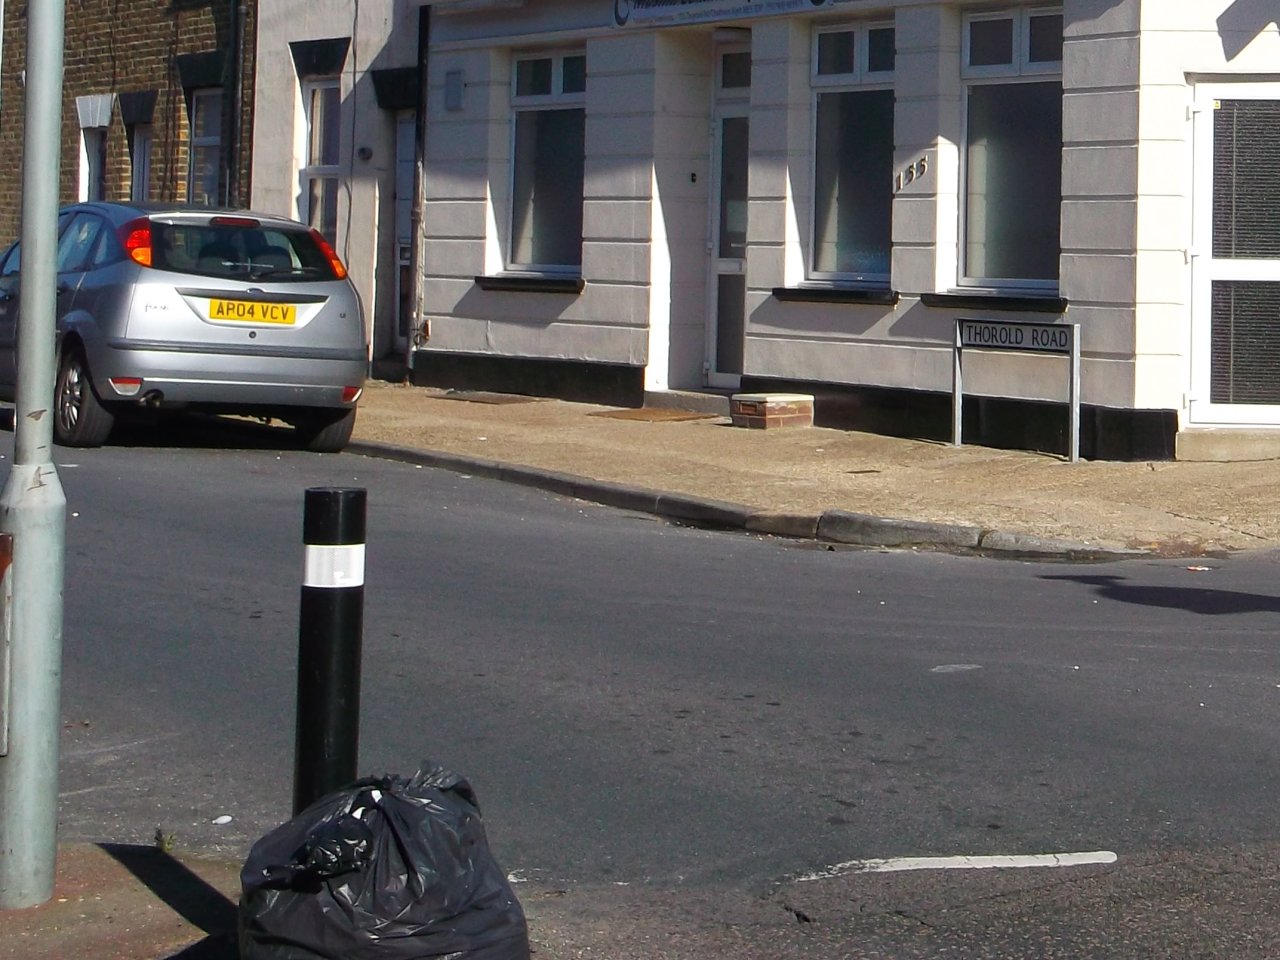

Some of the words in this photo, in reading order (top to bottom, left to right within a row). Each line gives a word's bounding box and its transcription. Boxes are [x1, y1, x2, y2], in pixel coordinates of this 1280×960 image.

[896, 155, 927, 192] 155
[216, 301, 255, 318] AP04
[261, 304, 289, 321] VCV
[966, 324, 1024, 345] THOROLD
[1032, 328, 1068, 347] ROAD
